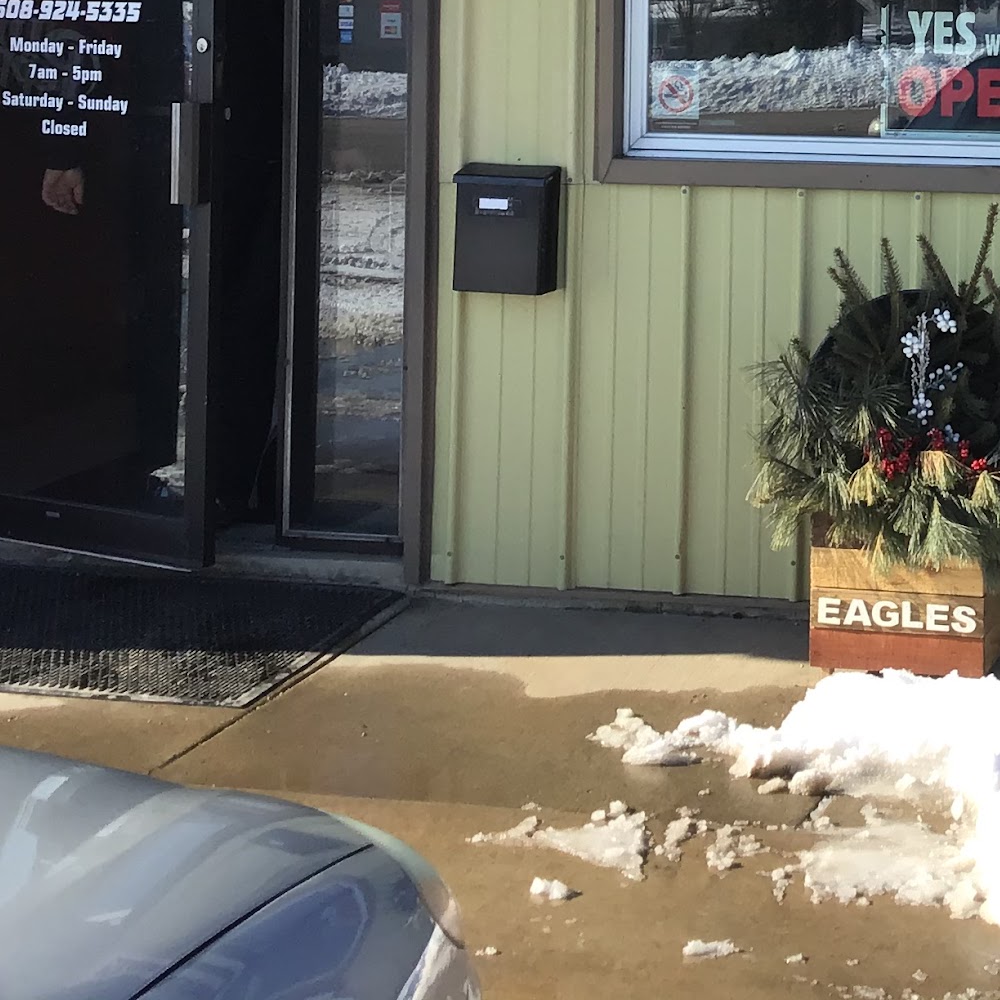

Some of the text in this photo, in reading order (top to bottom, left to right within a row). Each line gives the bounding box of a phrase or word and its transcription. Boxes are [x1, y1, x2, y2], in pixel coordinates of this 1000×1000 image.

[907, 10, 976, 55] YES
[9, 37, 64, 57] Monday
[79, 39, 122, 58] Friday
[28, 63, 58, 80] 7am
[72, 65, 103, 84] 5pm
[2, 90, 64, 112] Saturday
[78, 94, 129, 115] Sunday
[41, 119, 88, 137] Closed
[817, 596, 977, 634] EAGLES
